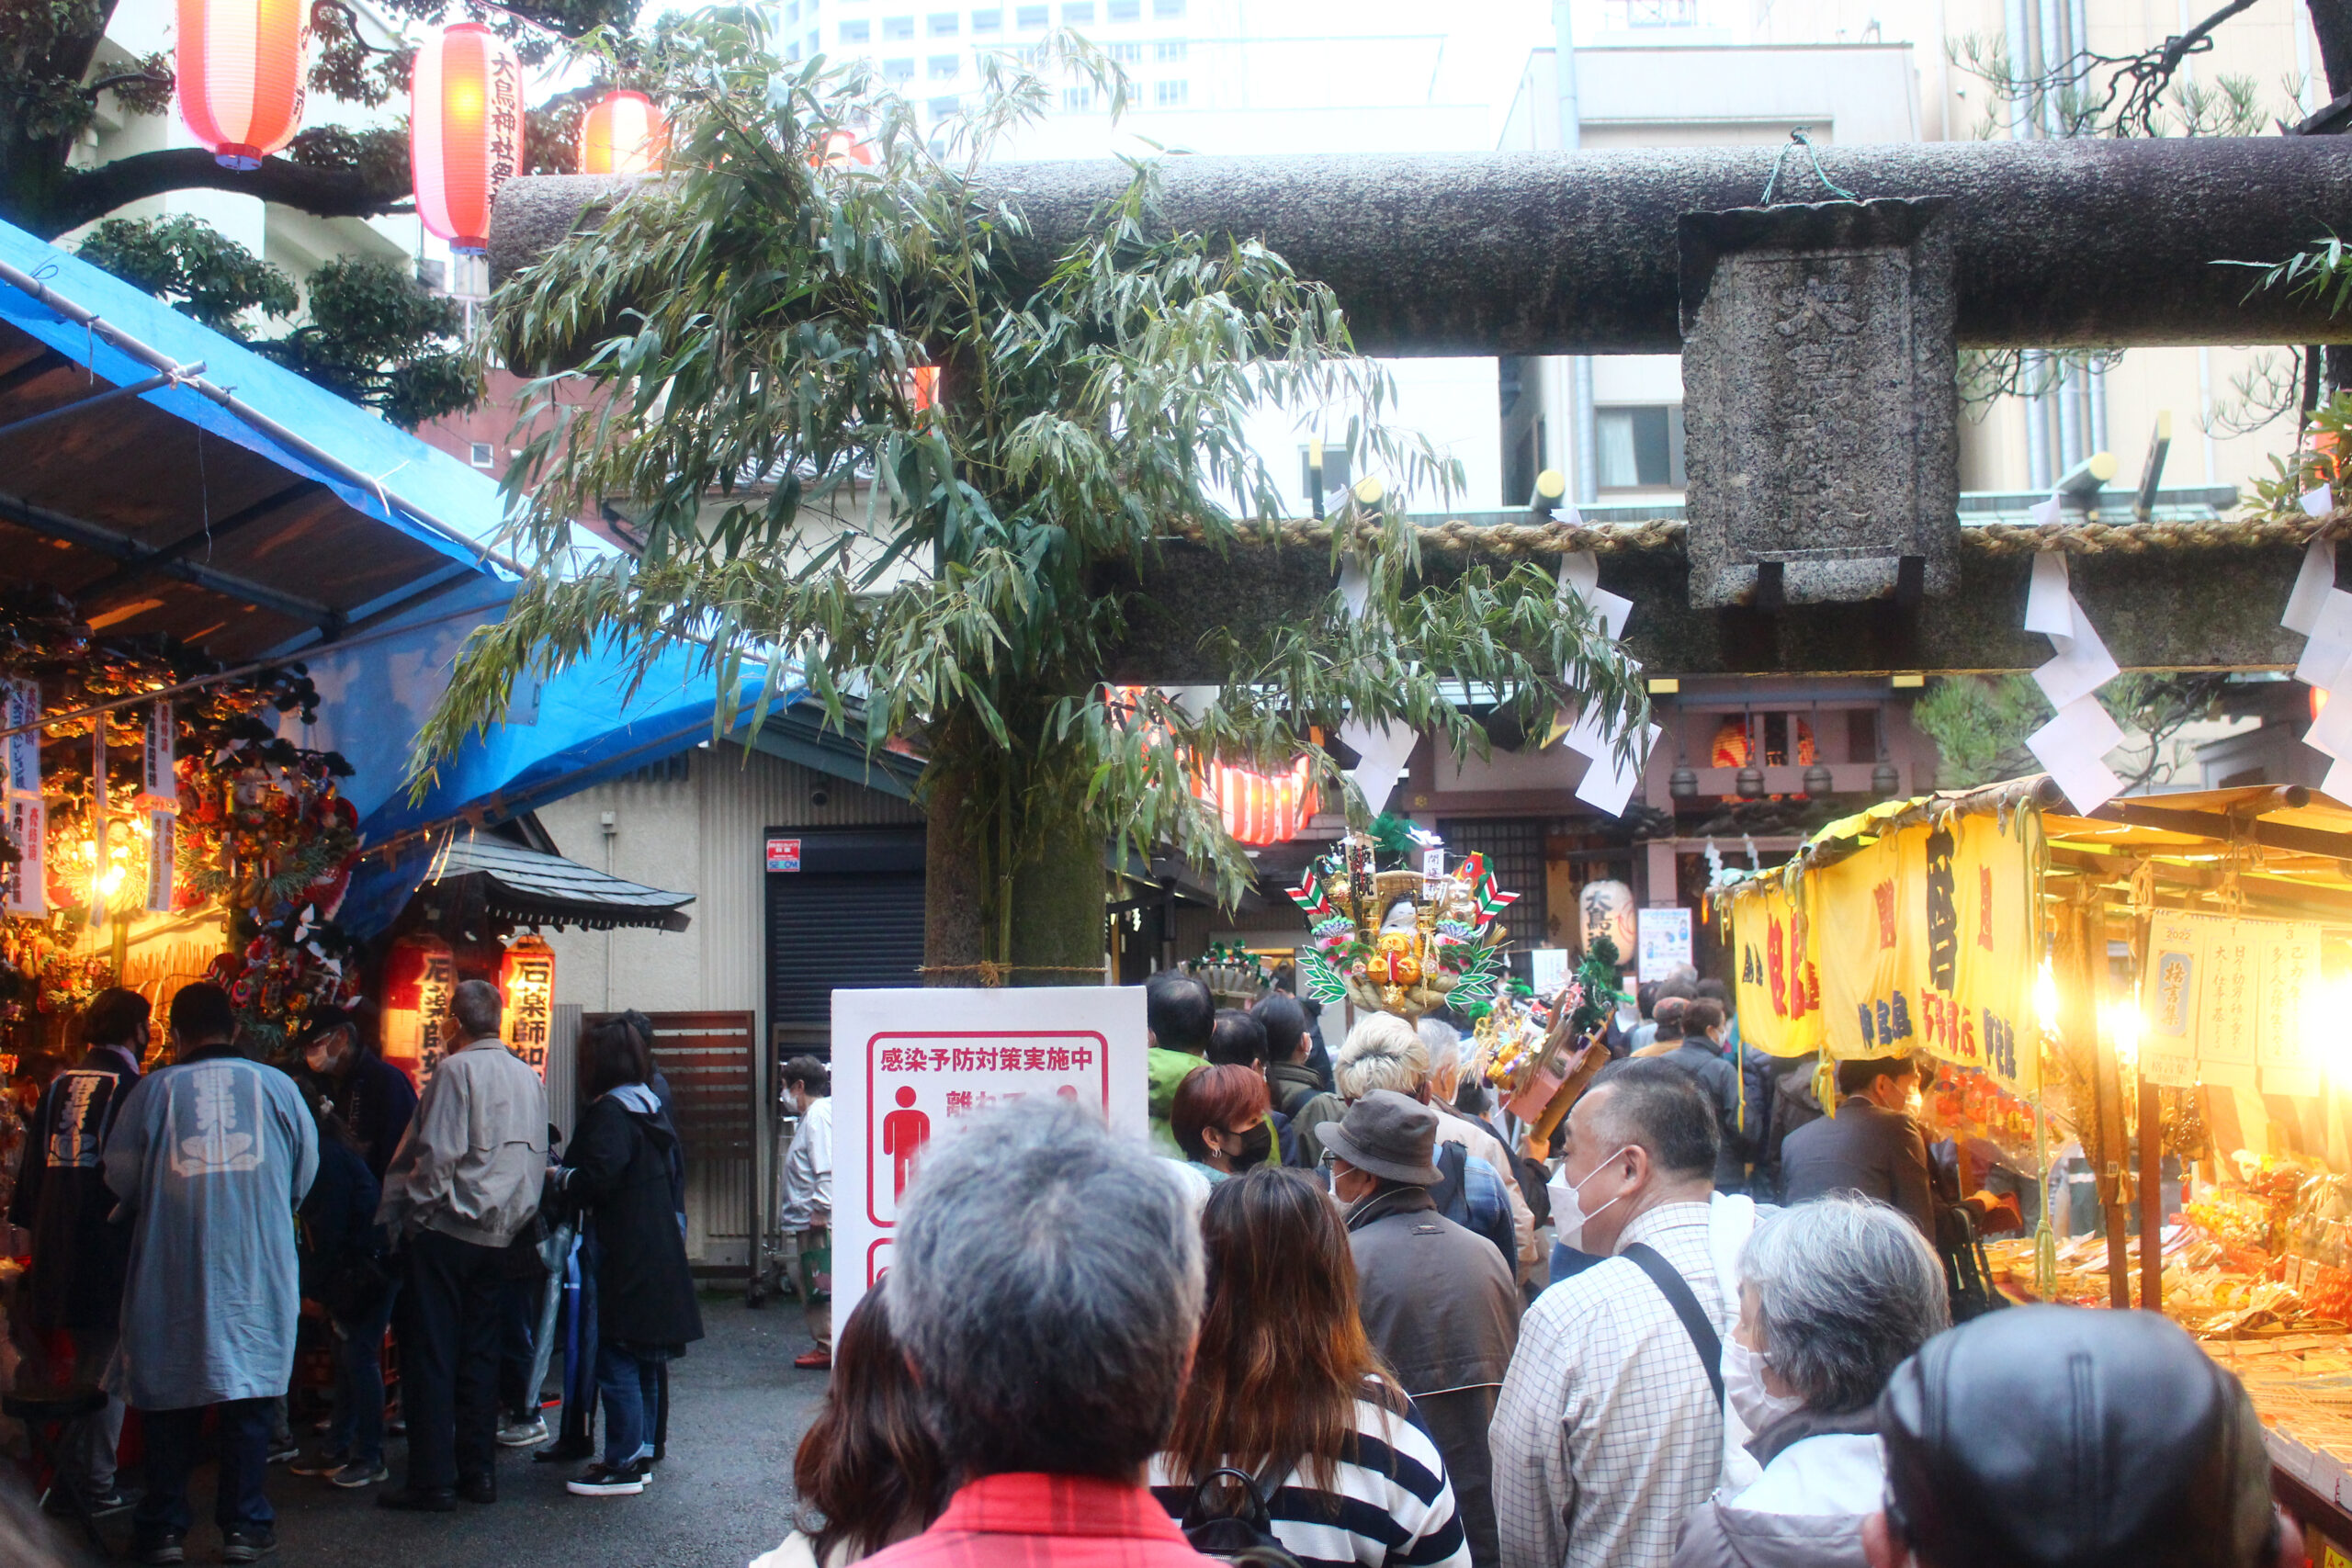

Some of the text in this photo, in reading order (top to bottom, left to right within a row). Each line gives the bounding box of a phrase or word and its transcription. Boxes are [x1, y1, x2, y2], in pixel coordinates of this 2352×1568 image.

[2165, 930, 2192, 941] 2022
[418, 957, 450, 1086] 石薬師如
[513, 961, 550, 1077] 石薬師如
[2164, 961, 2188, 1027] 格言集
[880, 1047, 1093, 1072] 感染予防対策実施中
